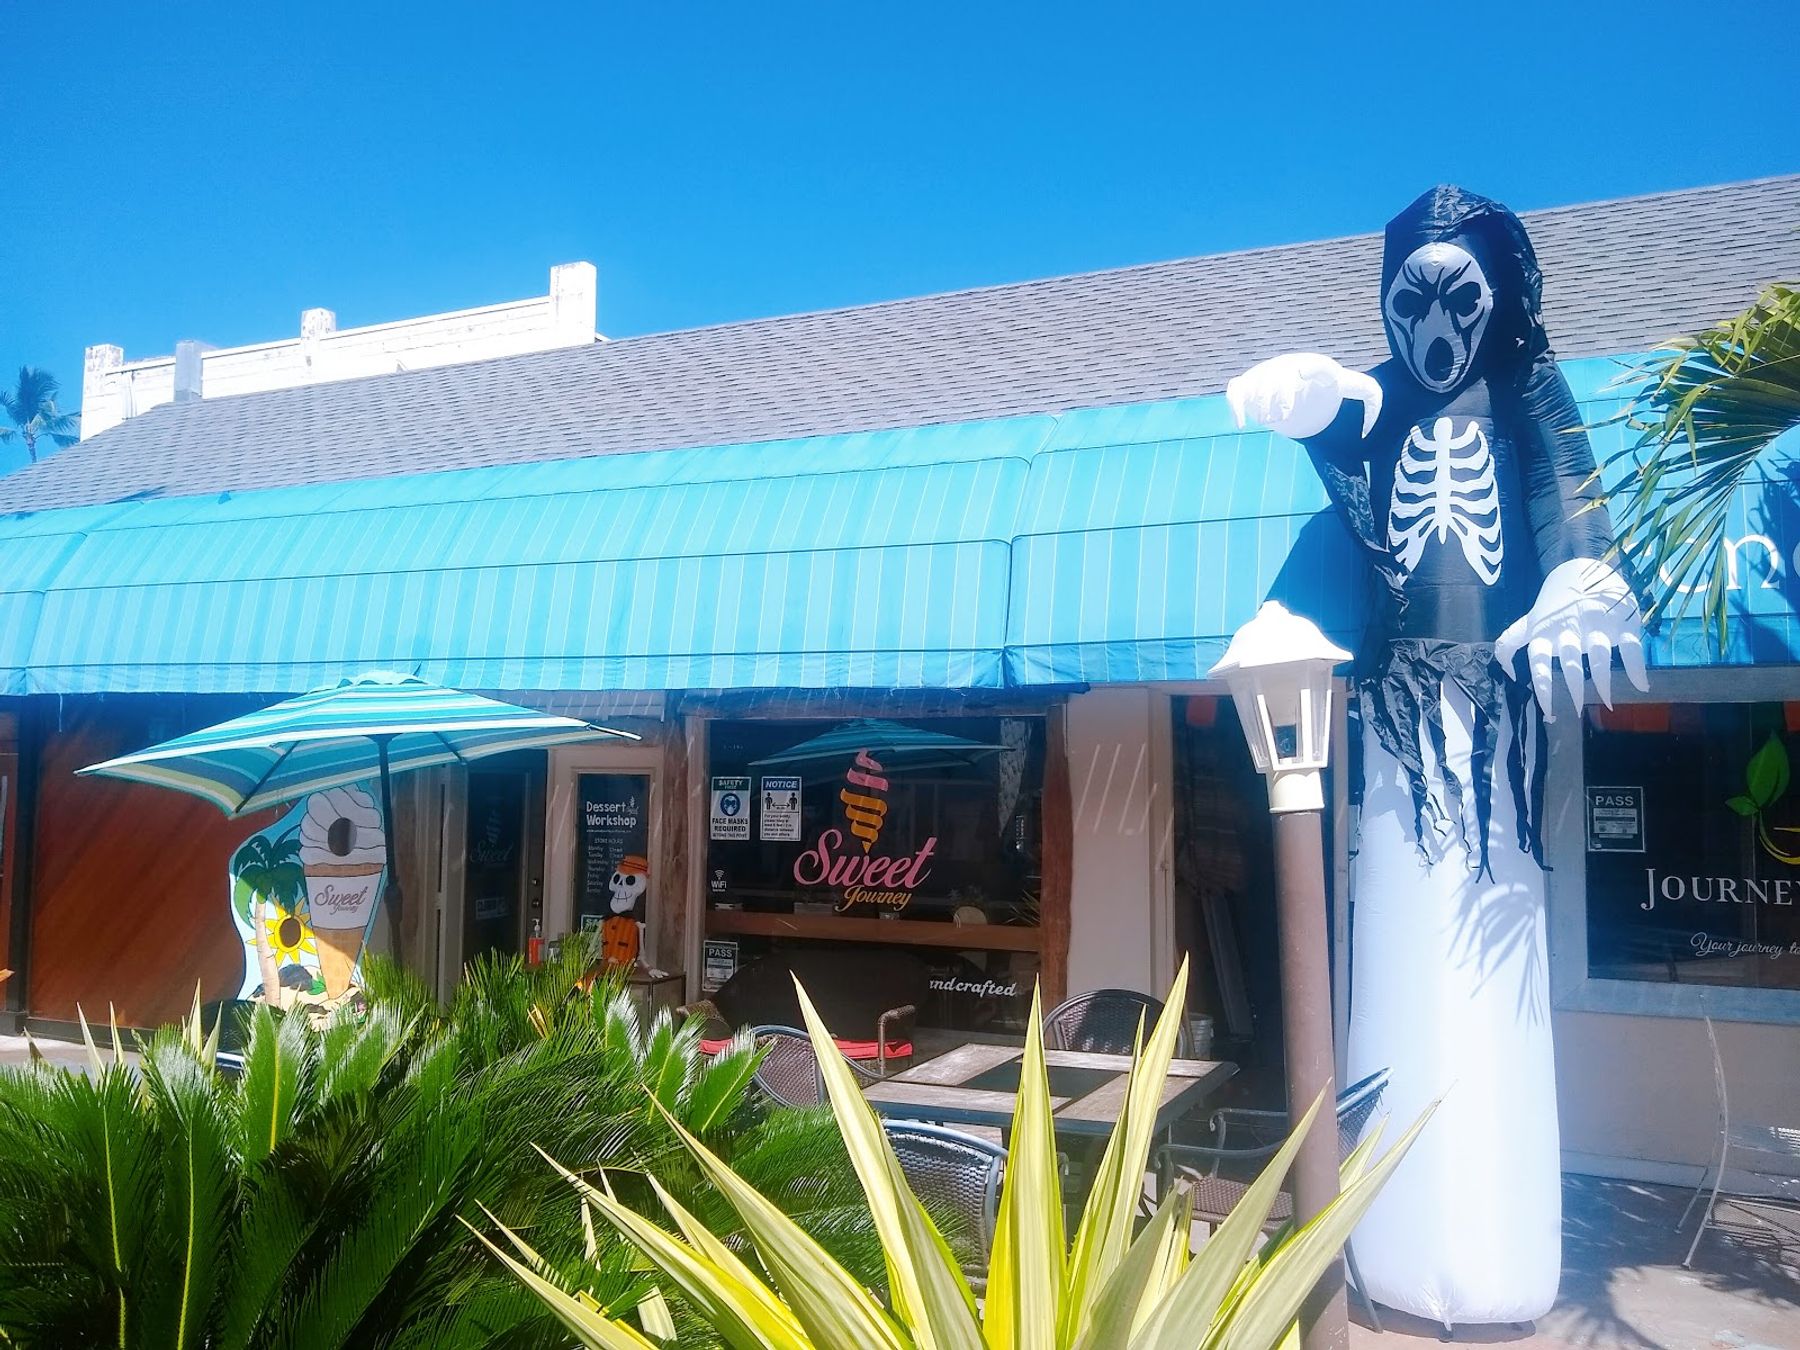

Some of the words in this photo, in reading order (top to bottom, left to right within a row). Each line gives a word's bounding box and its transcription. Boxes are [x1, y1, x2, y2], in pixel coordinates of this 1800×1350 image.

[765, 780, 798, 789] NOTICE
[586, 801, 626, 813] Dessert
[1595, 795, 1634, 806] PASS
[586, 814, 637, 828] Workshop
[793, 829, 937, 889] Sweet
[314, 884, 369, 907] Sweet
[834, 885, 912, 912] Journey
[1640, 868, 1800, 911] JOURNE
[708, 948, 733, 958] PASS
[1690, 931, 1737, 957] Your
[1728, 941, 1784, 960] journey
